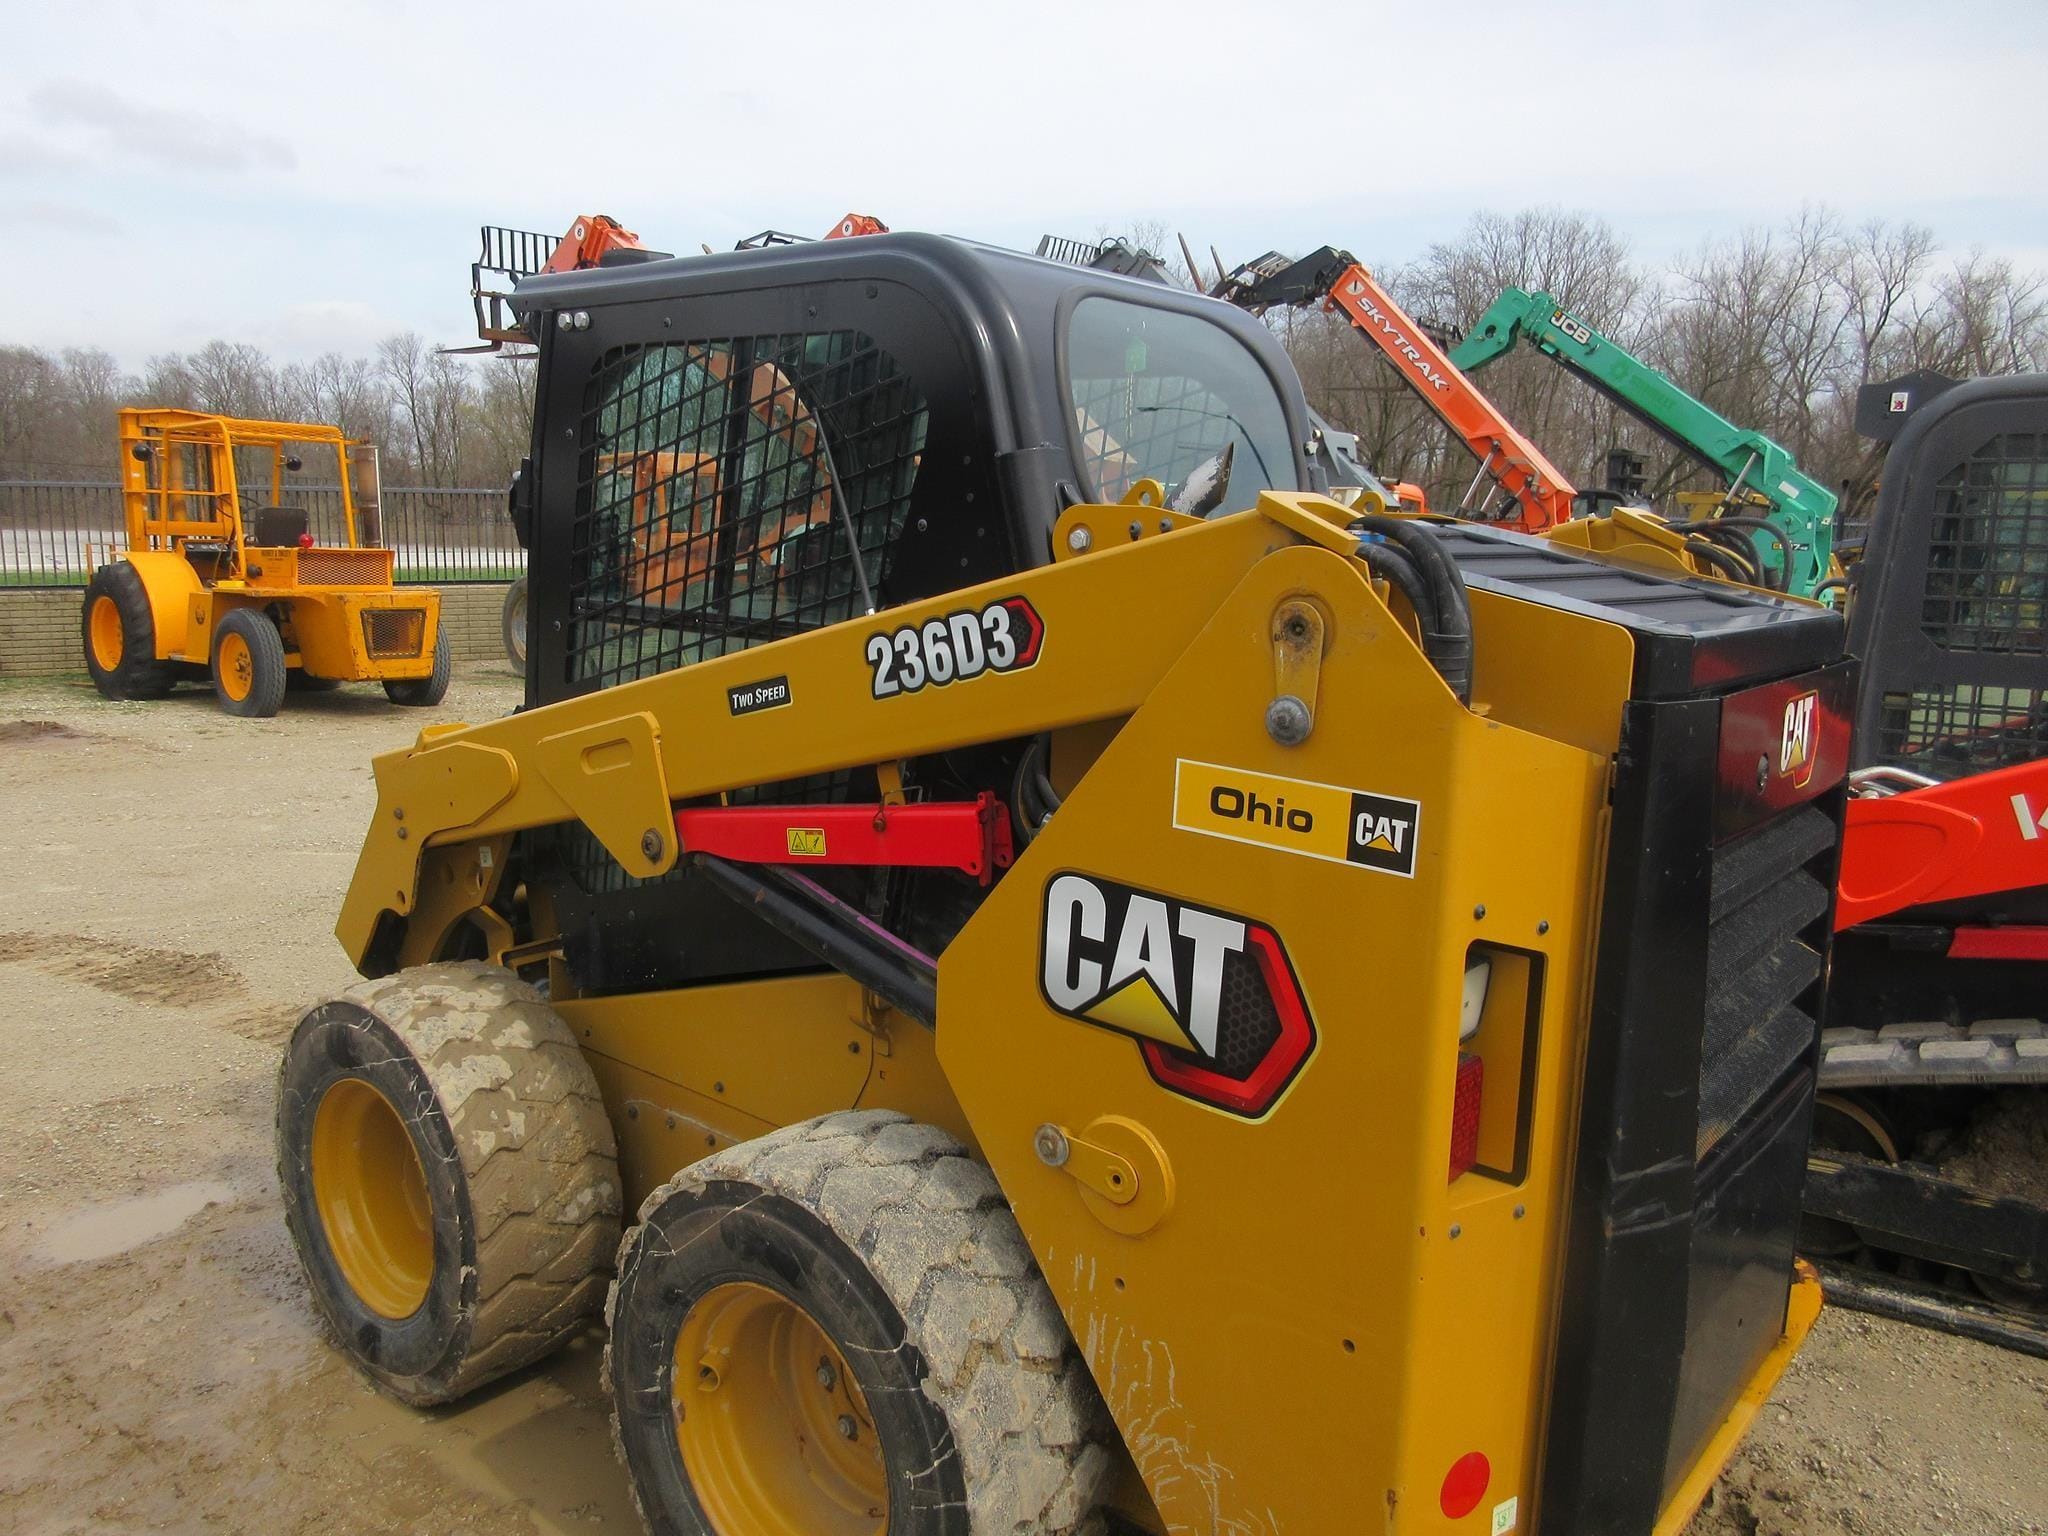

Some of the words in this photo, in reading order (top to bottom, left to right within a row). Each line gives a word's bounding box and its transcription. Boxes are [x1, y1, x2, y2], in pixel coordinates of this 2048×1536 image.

[1356, 297, 1450, 390] SKYTRAK
[1550, 314, 1591, 344] JCB
[867, 604, 1016, 696] 236D3
[1781, 695, 1814, 772] CAT
[1210, 786, 1313, 833] Ohio
[1355, 812, 1408, 854] CAT
[1044, 875, 1246, 1059] CAT
